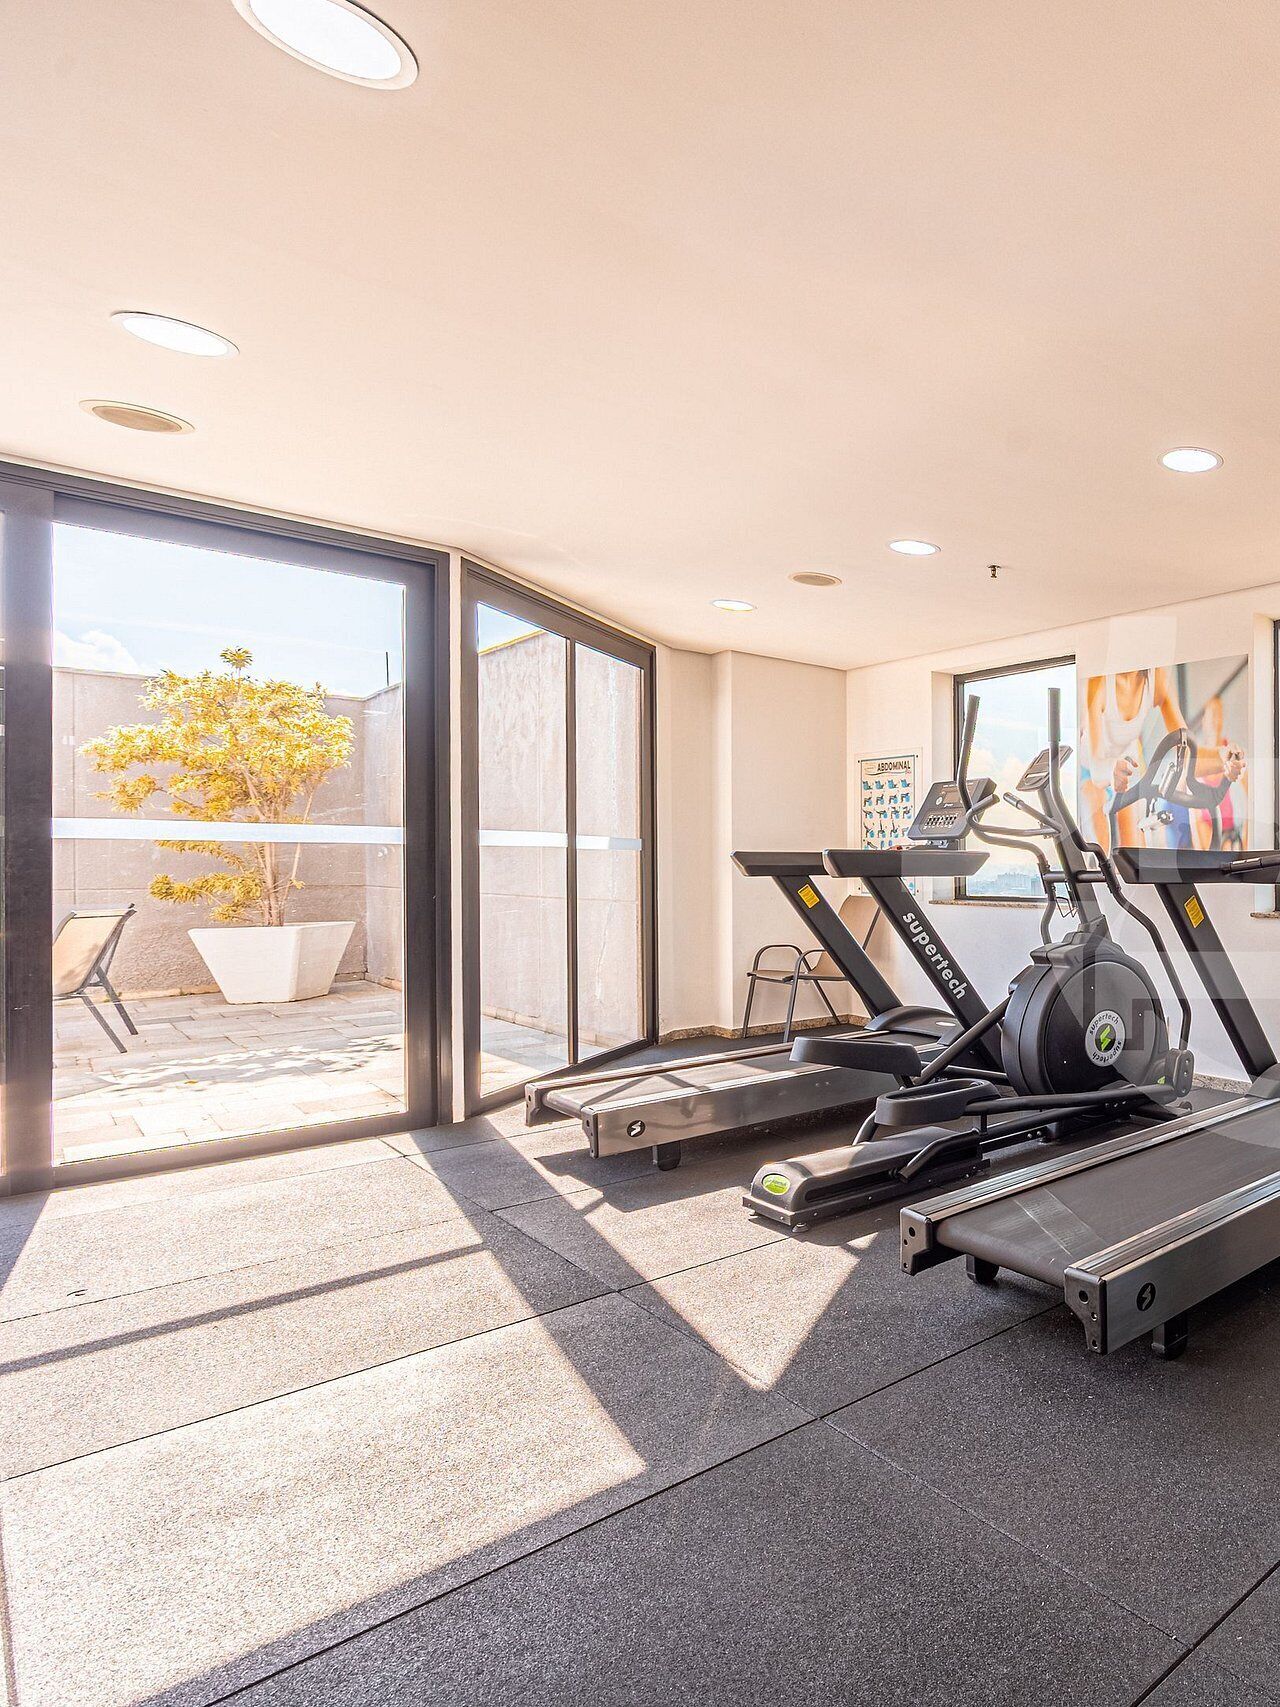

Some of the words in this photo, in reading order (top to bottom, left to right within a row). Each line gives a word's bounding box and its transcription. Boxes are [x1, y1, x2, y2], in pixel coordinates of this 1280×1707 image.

[877, 761, 911, 771] ABDOMINAL
[902, 912, 967, 999] supertech
[1089, 1013, 1119, 1035] supertech
[1092, 1041, 1122, 1062] supertech
